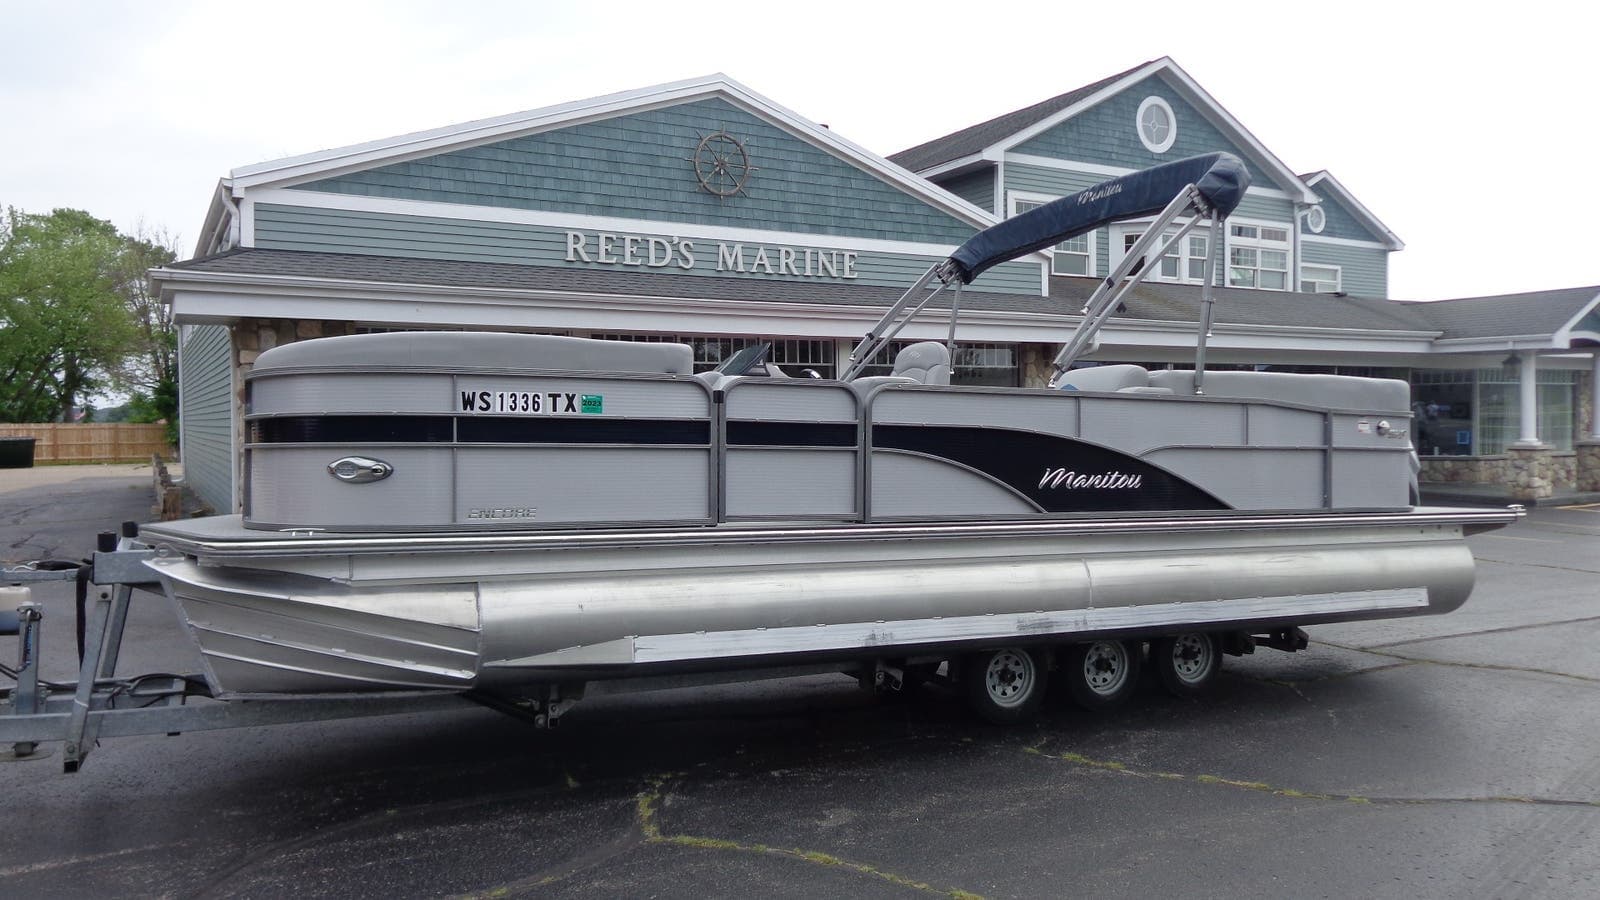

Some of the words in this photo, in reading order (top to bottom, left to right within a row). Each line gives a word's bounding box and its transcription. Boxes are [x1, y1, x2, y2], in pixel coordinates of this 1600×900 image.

[565, 231, 695, 270] REED'S
[715, 242, 859, 279] MARINE
[461, 391, 491, 412] WS
[499, 393, 541, 412] 1336
[548, 393, 577, 413] TX
[1038, 467, 1142, 489] Manitou
[468, 508, 537, 520] ENCORE
